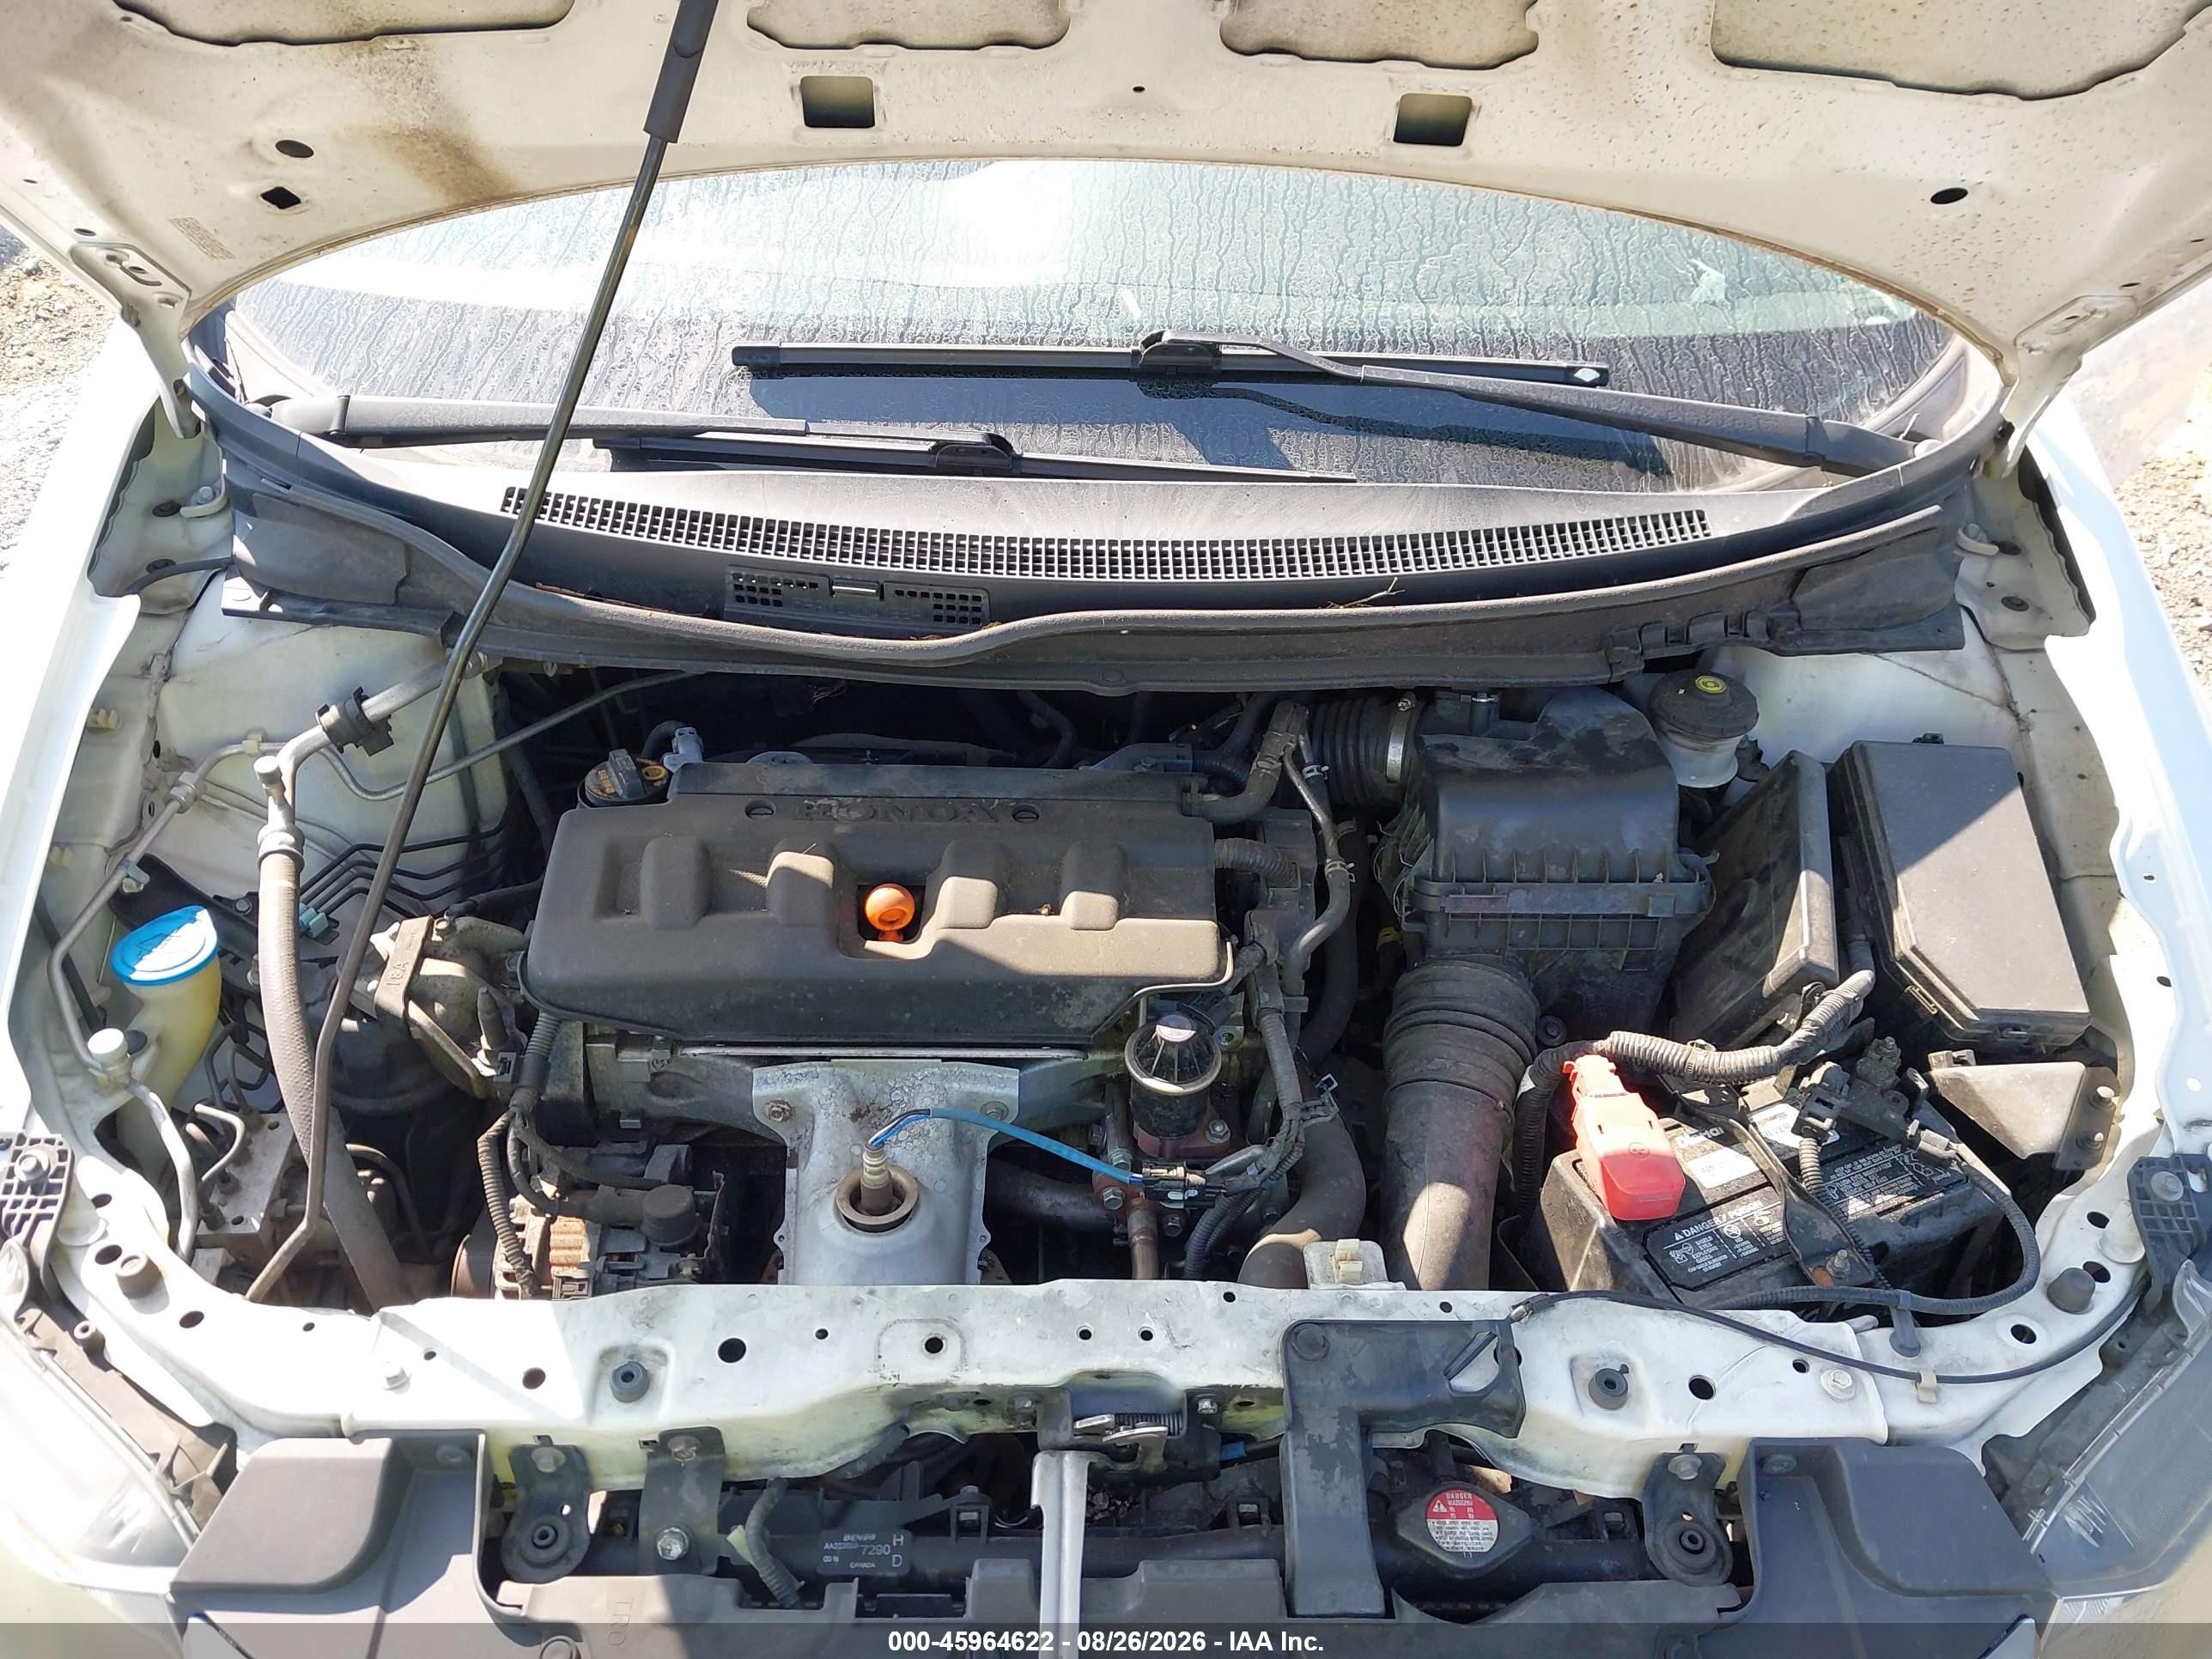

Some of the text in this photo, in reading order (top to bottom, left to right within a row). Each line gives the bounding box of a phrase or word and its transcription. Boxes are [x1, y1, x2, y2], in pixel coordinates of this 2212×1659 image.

[795, 798, 1000, 823] HONDA
[893, 1534, 904, 1546] H
[892, 1554, 903, 1567] D
